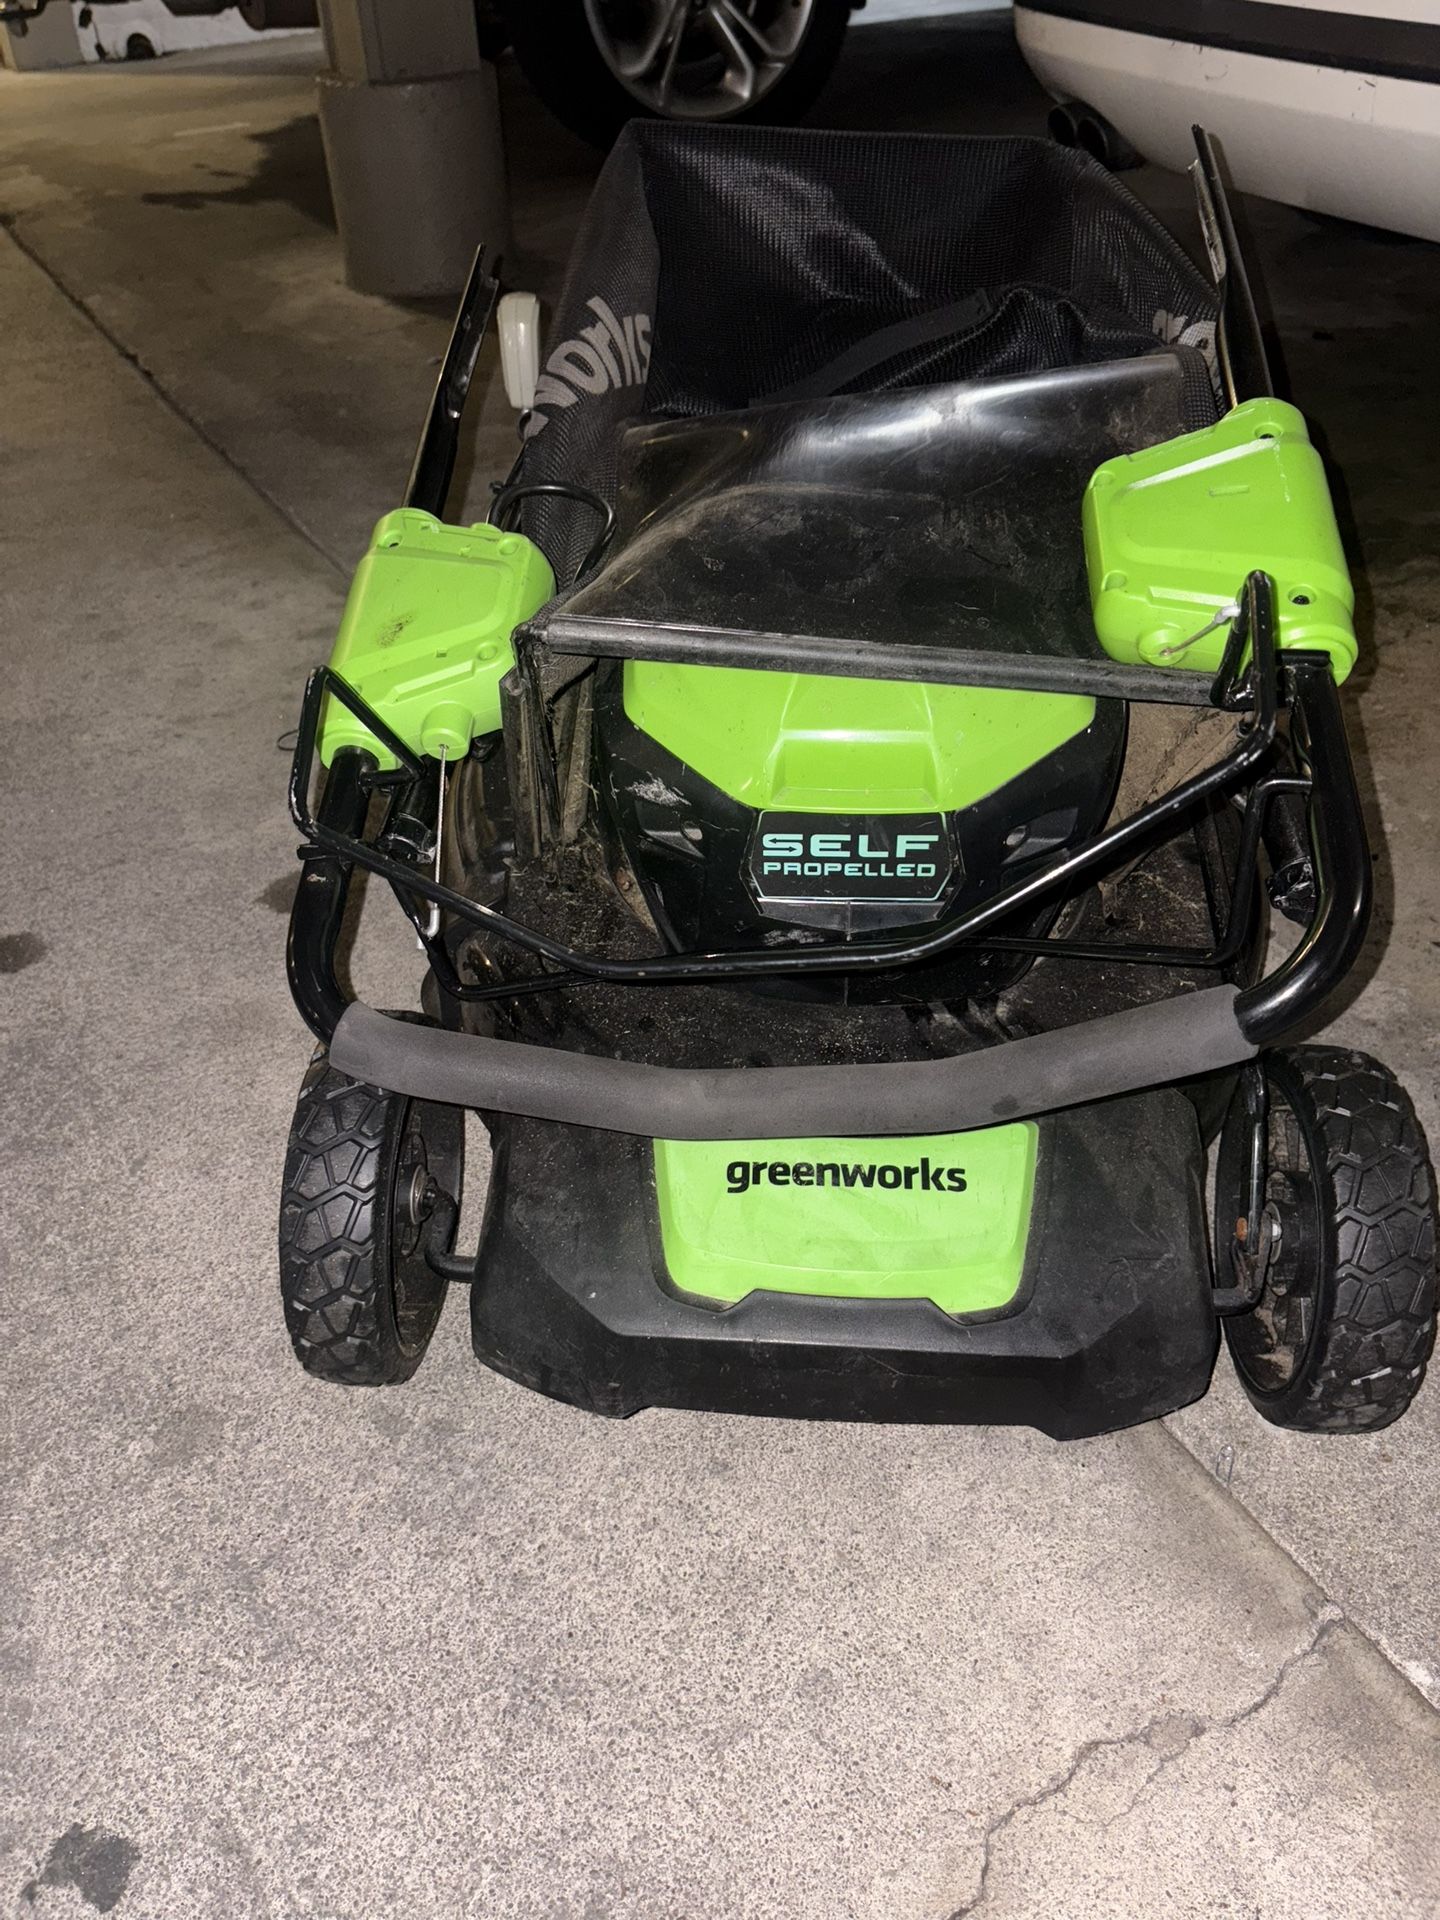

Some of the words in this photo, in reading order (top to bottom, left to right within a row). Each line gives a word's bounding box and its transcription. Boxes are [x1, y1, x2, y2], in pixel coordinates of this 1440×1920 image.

[762, 833, 940, 859] SELF
[763, 861, 936, 878] PROPELLED
[726, 1157, 968, 1194] greenworks
